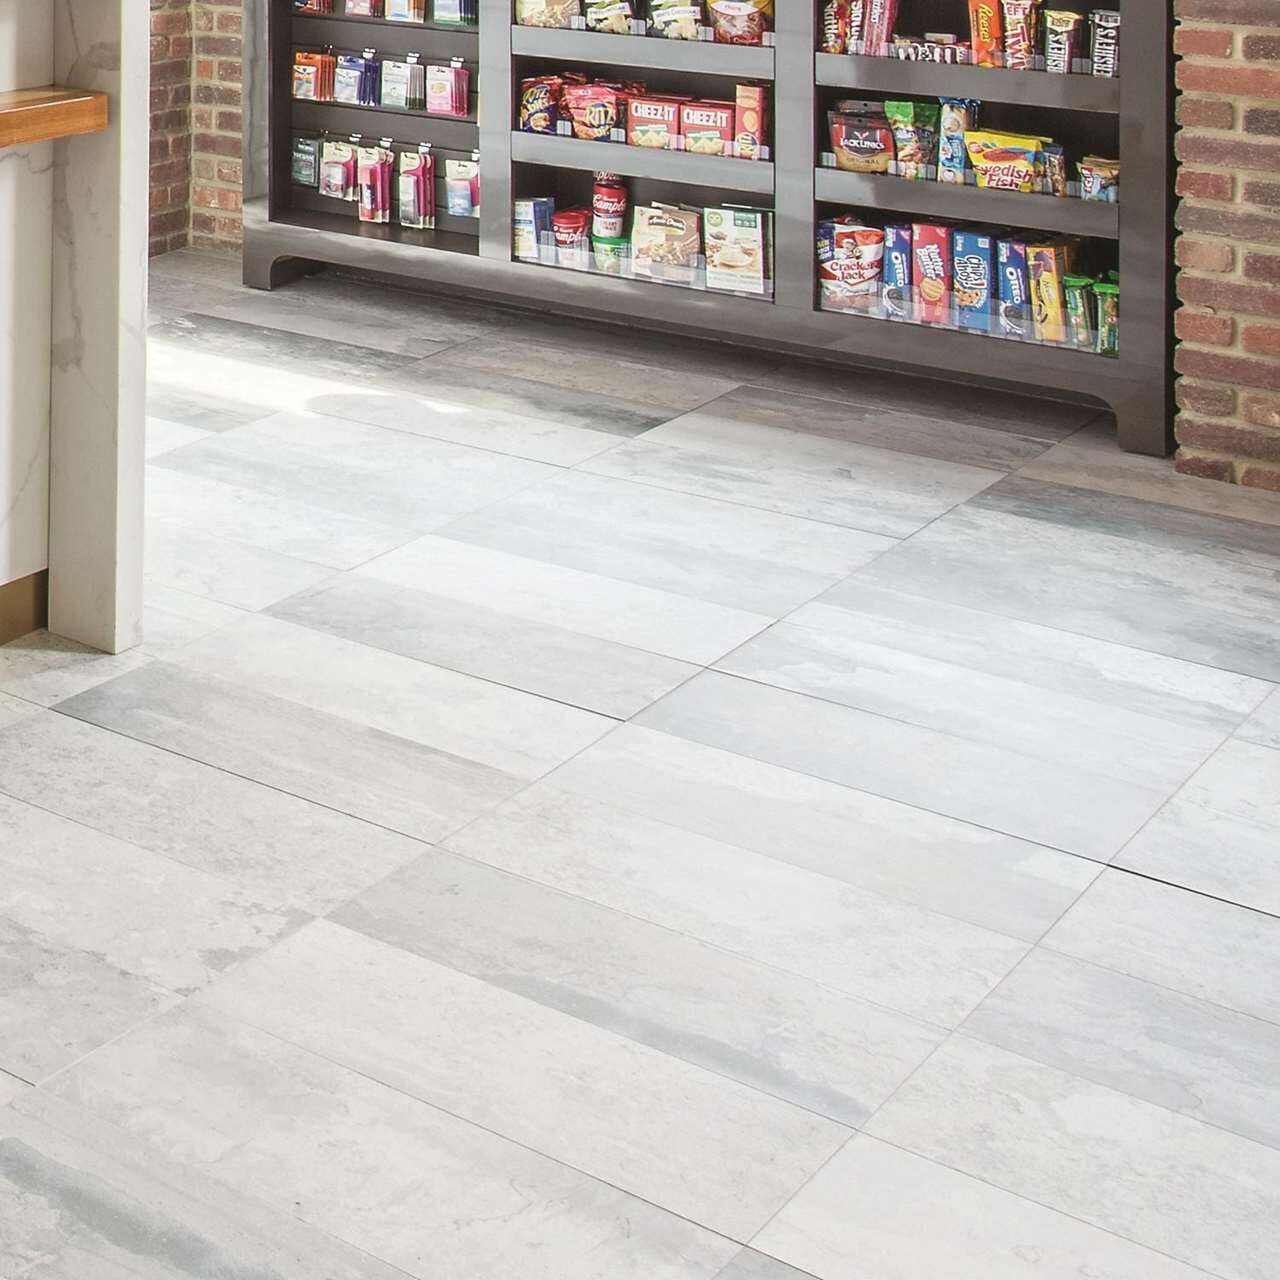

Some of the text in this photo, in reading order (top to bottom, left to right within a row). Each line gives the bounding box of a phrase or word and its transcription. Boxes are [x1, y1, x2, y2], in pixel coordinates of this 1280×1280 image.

[1003, 23, 1030, 70] TWI
[1093, 27, 1117, 78] ERSHEY'S
[631, 102, 676, 122] CHEEZ-IT
[683, 108, 729, 129] CHEEZ-IT
[987, 173, 1020, 189] Fish
[838, 269, 867, 281] Jack
[892, 251, 905, 287] OREO
[964, 254, 985, 284] Chips
[1005, 267, 1021, 304] OREO
